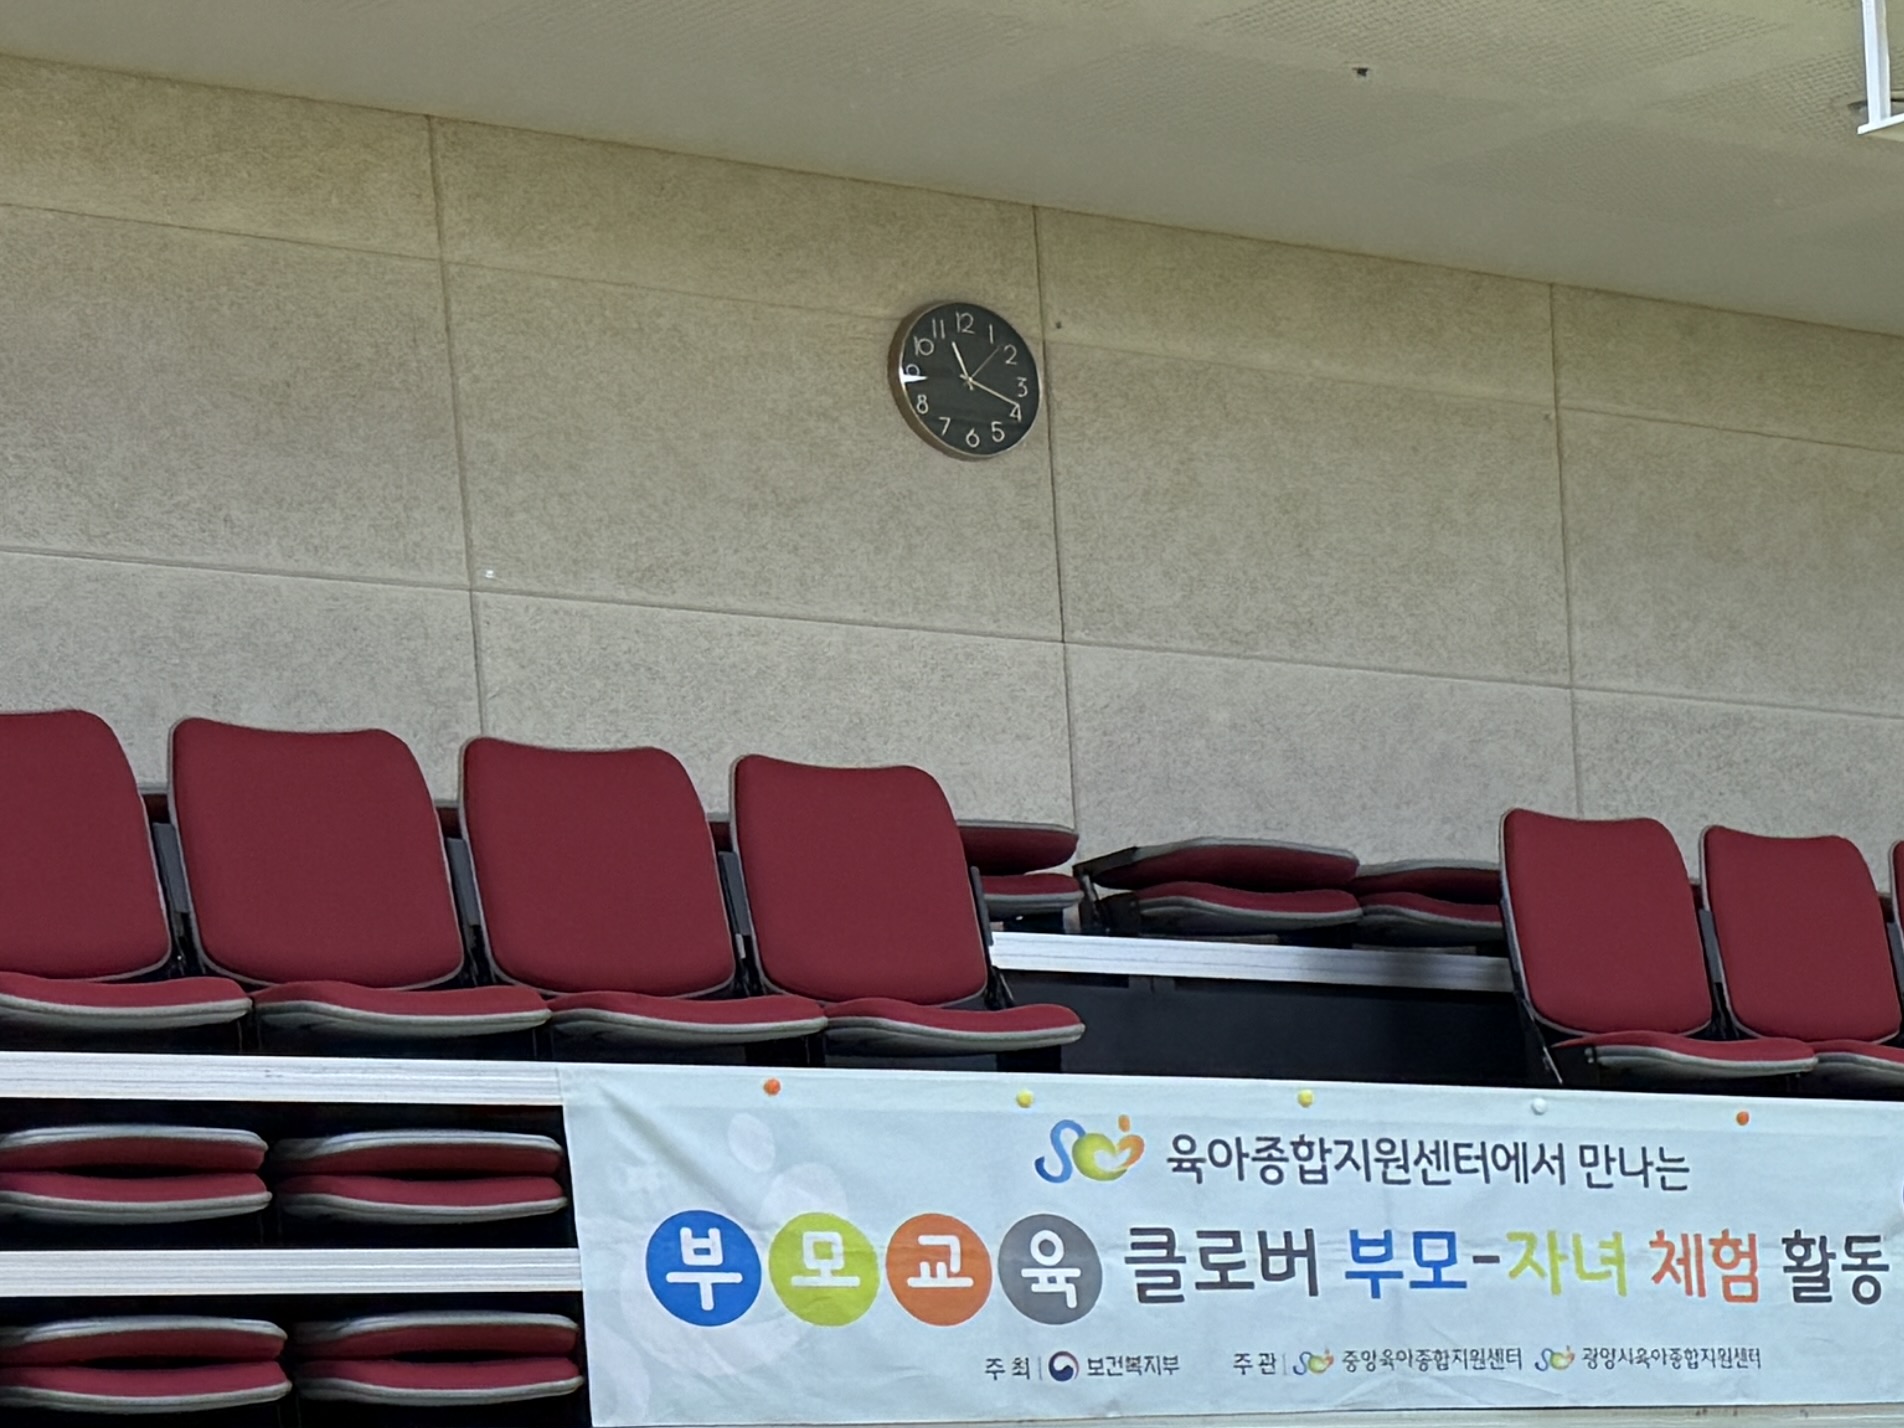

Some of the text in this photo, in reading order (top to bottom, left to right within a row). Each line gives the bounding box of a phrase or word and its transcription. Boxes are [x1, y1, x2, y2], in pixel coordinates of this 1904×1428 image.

[932, 318, 946, 339] 11
[955, 311, 975, 334] 12
[988, 323, 995, 345] 1
[913, 335, 935, 356] 10
[1004, 344, 1018, 366] 2
[1016, 377, 1028, 398] 3
[916, 395, 930, 414] 8
[1009, 404, 1022, 423] 4
[939, 417, 951, 437] 7
[991, 421, 1006, 443] 5
[965, 428, 981, 448] 6
[1165, 1133, 1692, 1191] 육아종합지원센터에서 만나는
[1124, 1225, 1320, 1304] 클로버
[1344, 1227, 1628, 1300] 부모-자녀
[1649, 1228, 1759, 1304] 체험
[1781, 1228, 1890, 1306] 활동
[1086, 1354, 1181, 1377] 보건복지부
[1342, 1348, 1523, 1372] 중앙육아종합지원센터
[1582, 1346, 1761, 1371] 광양시육아종합지원센터
